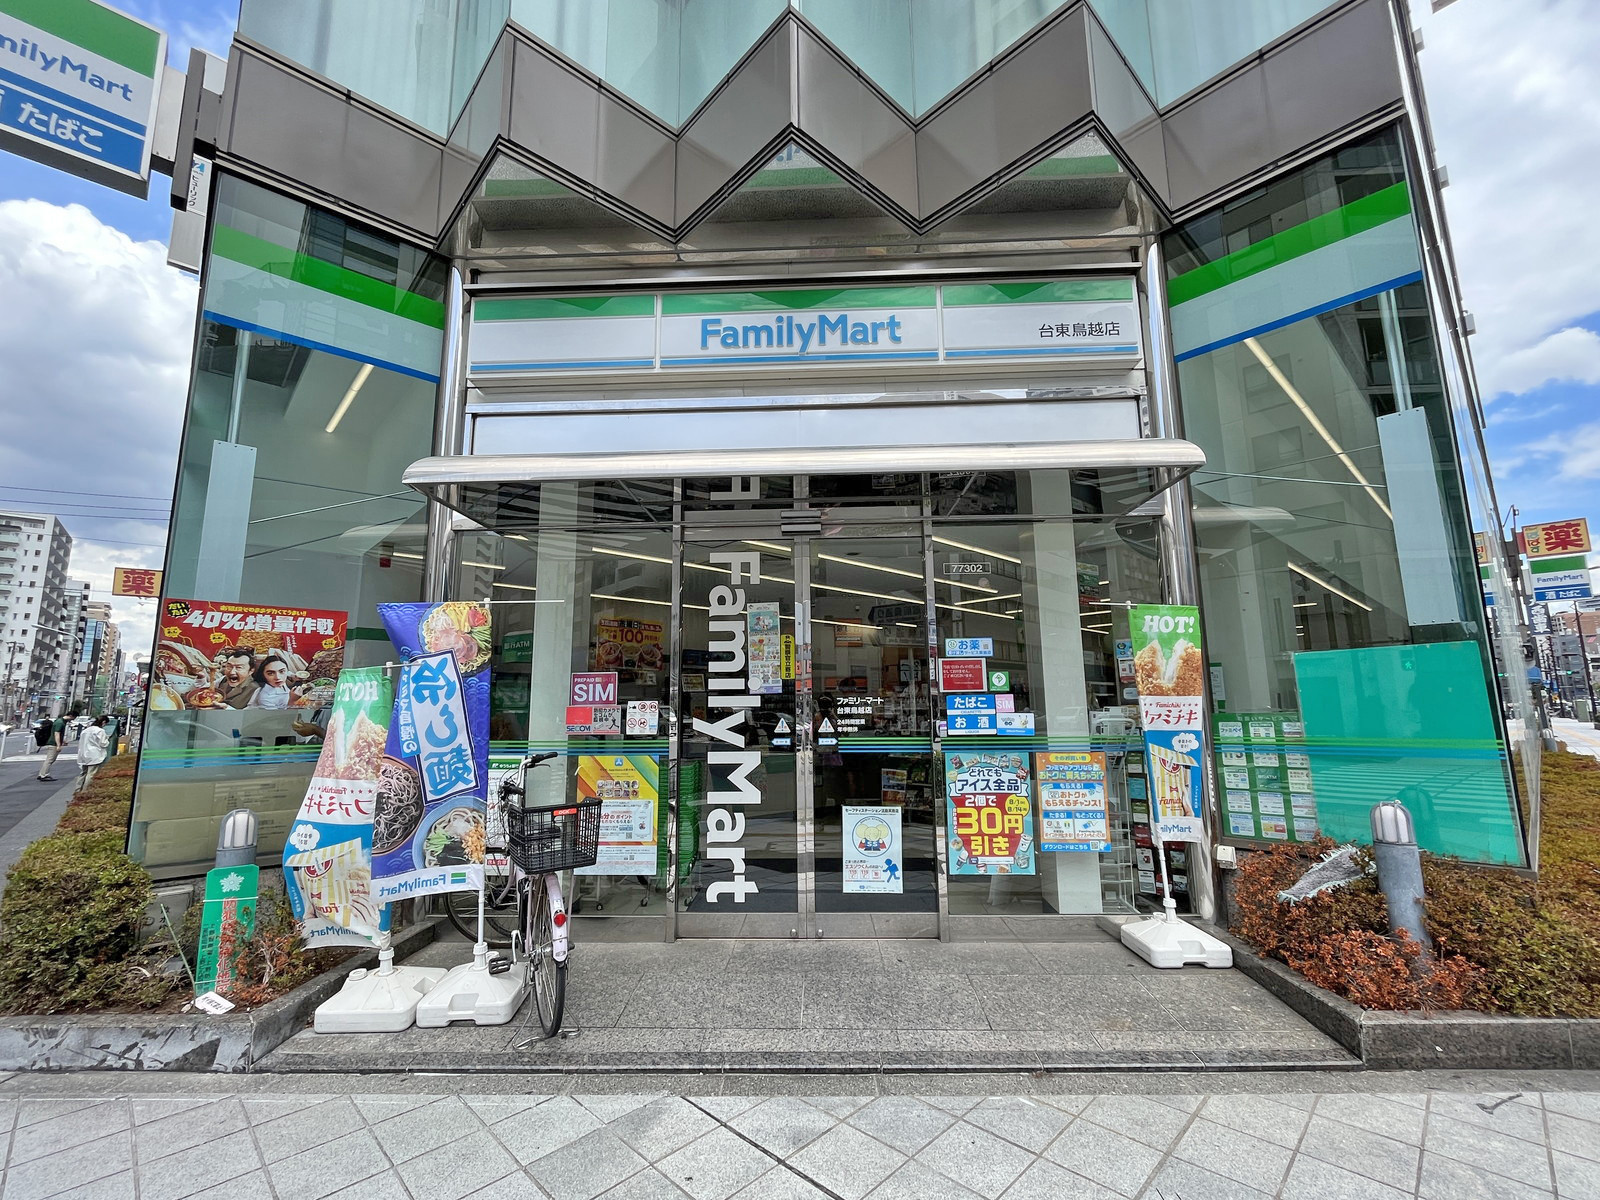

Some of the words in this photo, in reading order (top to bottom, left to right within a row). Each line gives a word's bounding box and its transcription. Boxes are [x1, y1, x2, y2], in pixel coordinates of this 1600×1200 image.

[18, 102, 103, 152] たばこ
[701, 314, 902, 355] FamilyMart
[1038, 321, 1121, 339] 台東鳥越店
[1542, 522, 1585, 552] 薬
[951, 564, 983, 573] 77302
[122, 570, 156, 594] 薬
[1537, 573, 1584, 584] FamilyMart
[183, 609, 335, 636] 40%増量作戦
[1143, 615, 1195, 634] HOT!
[573, 683, 614, 702] SIM
[836, 696, 884, 705] ファミリーマート
[837, 706, 873, 715] 台東鳥越店
[954, 696, 988, 709] たばこ
[692, 552, 761, 903] FamilyMart
[968, 768, 1002, 778] どれでも
[957, 778, 1020, 792] アイス全品
[965, 794, 997, 807] 2個で
[957, 807, 1024, 834] 30円
[970, 836, 1010, 856] 引き
